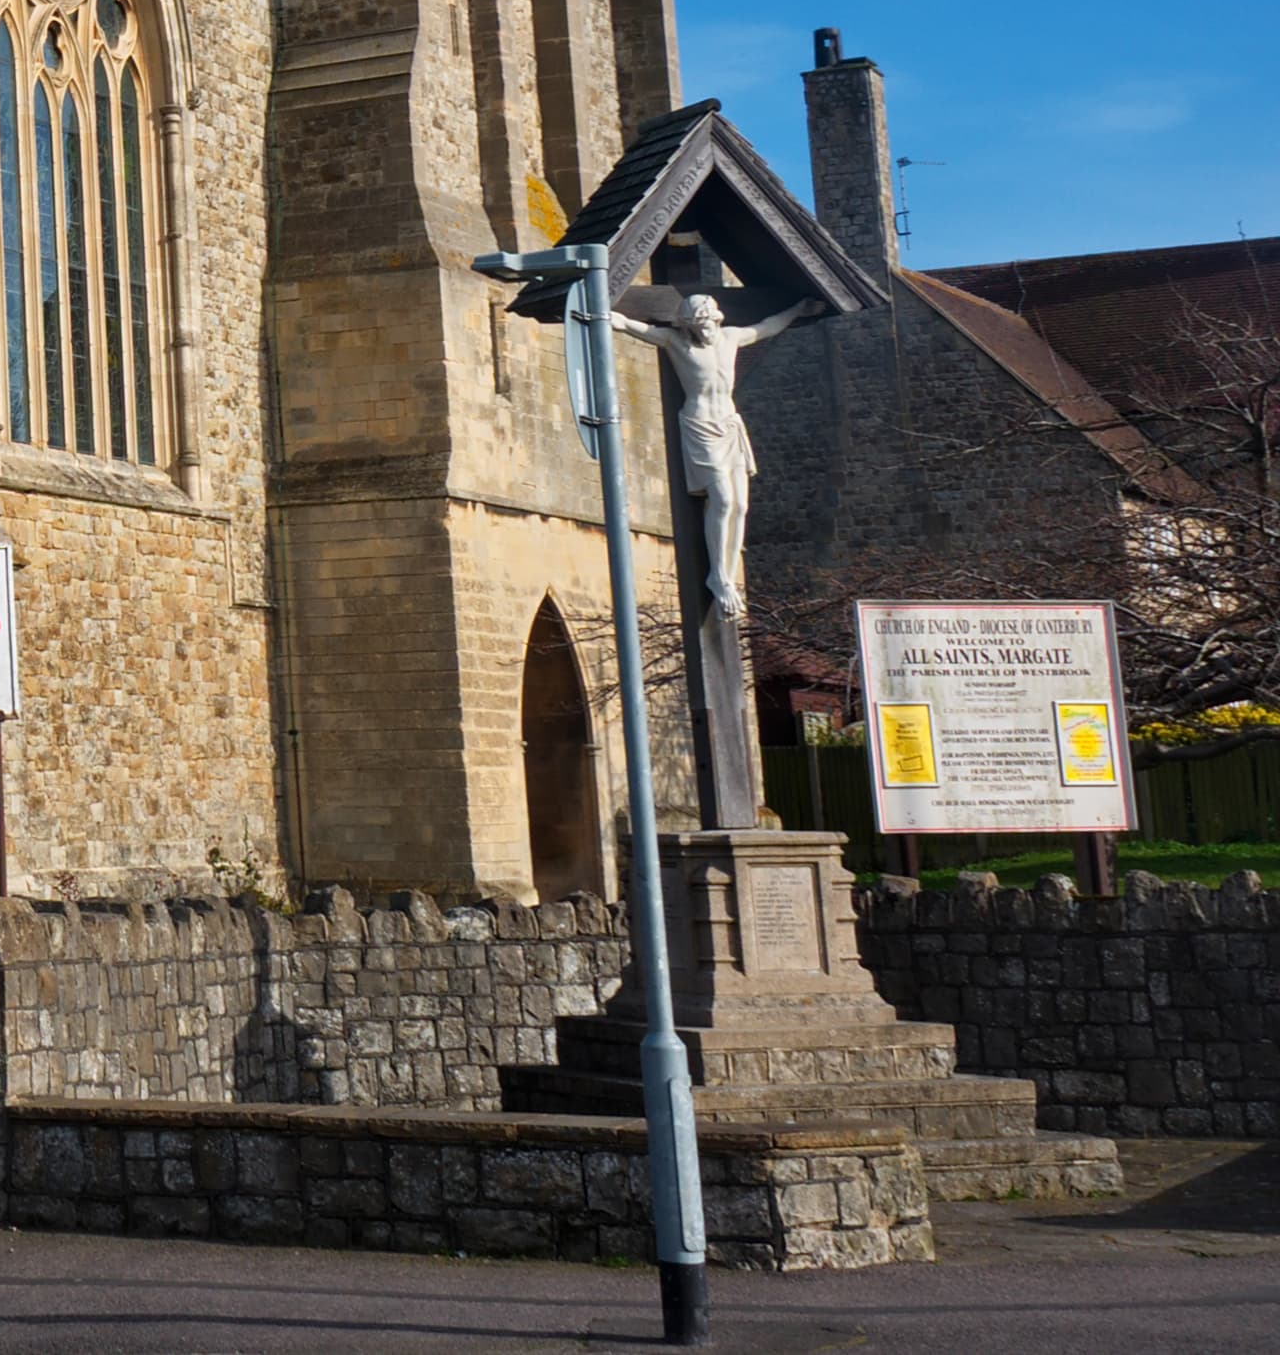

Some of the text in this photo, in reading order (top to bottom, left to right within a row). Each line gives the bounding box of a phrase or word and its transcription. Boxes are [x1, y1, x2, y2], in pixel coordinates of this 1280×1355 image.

[874, 619, 1093, 634] CHURCH OF ENGLAND DIOCESE OF CANTERBURY
[902, 648, 1072, 665] ALL SAINTS, MARGATE
[887, 669, 908, 677] THE
